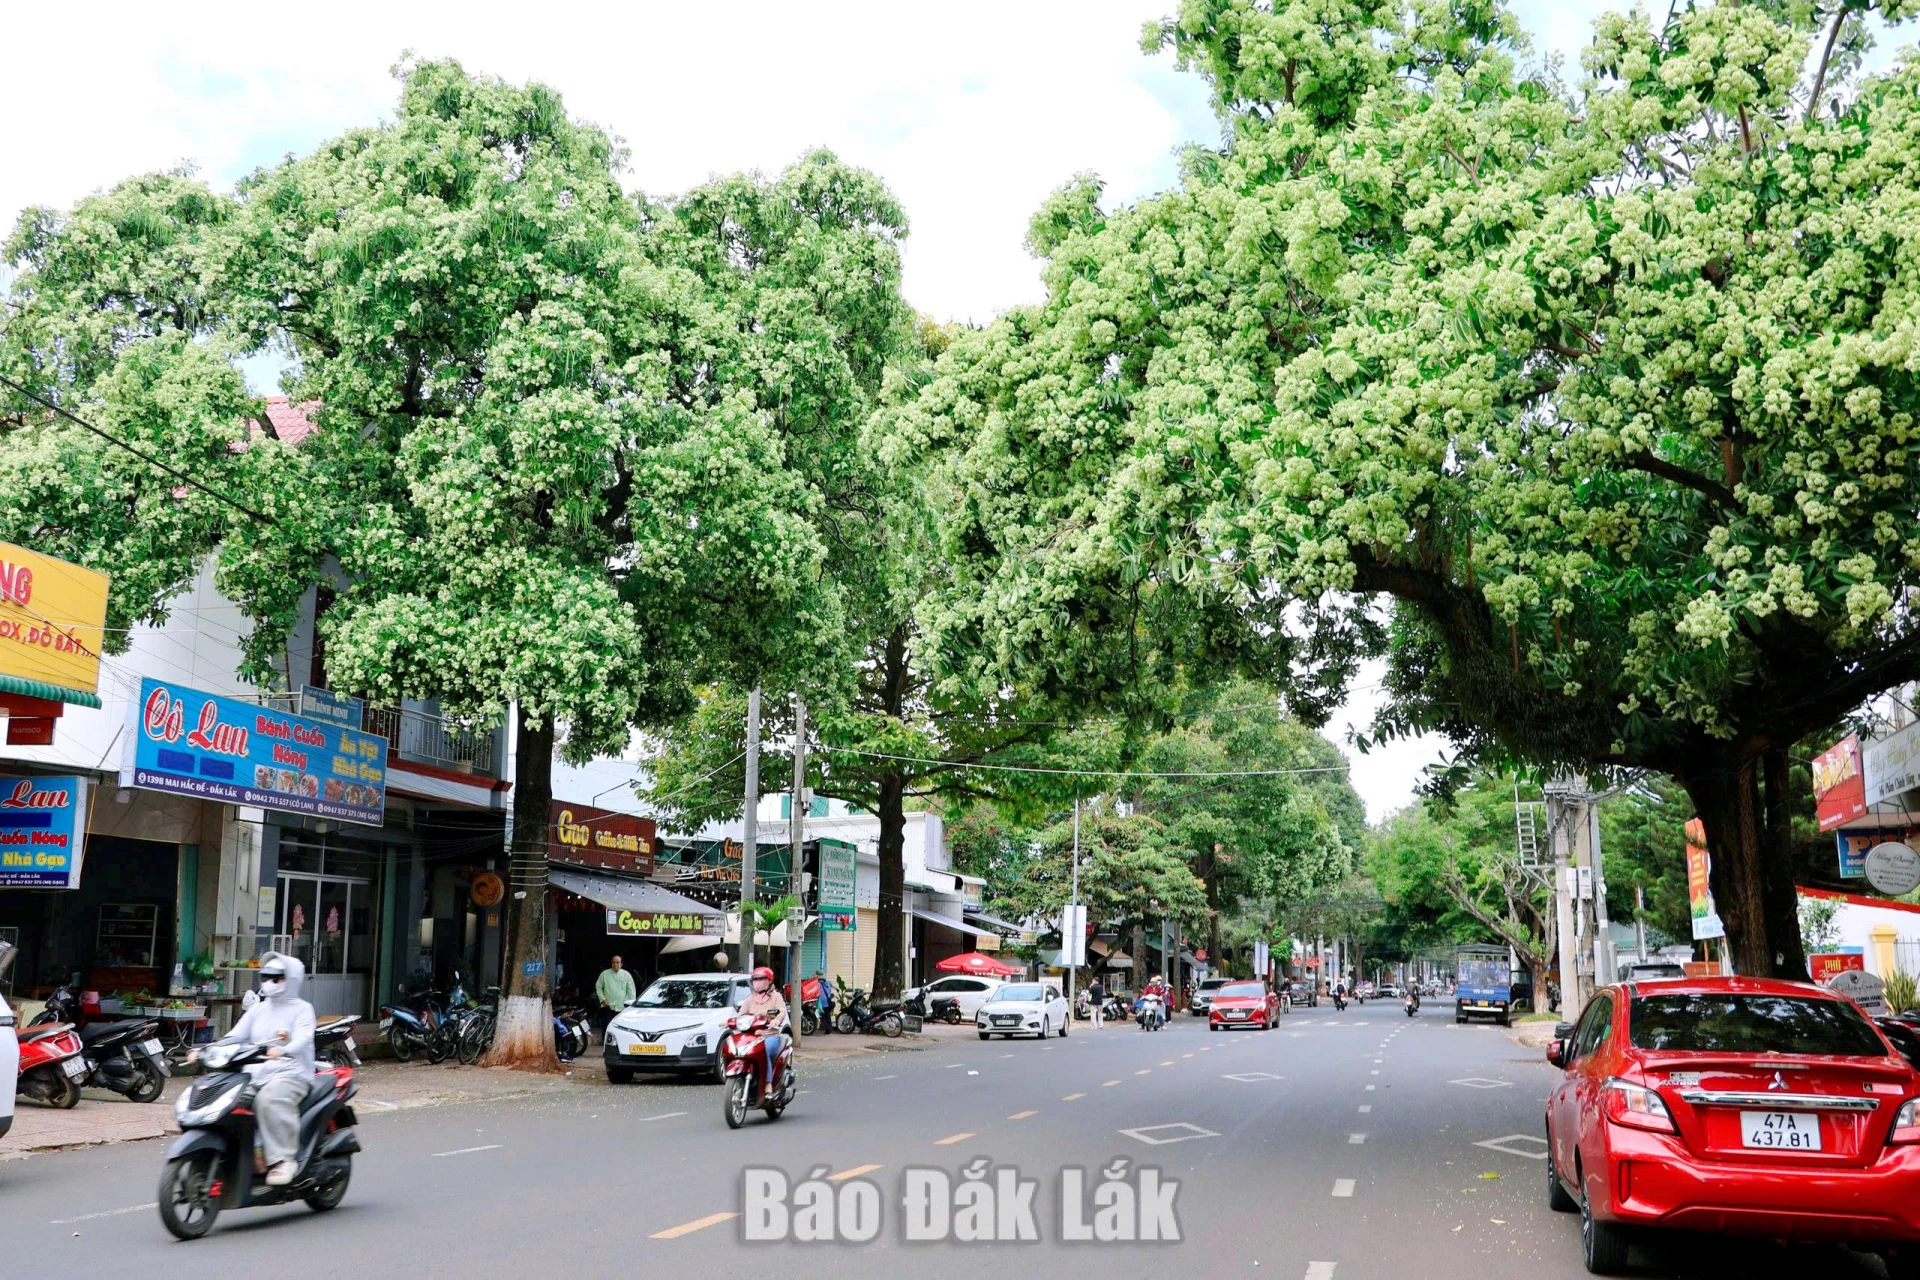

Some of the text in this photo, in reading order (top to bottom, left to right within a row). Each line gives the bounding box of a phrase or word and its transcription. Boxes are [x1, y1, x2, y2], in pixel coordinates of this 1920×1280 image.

[144, 687, 250, 757] Cô Lan
[257, 715, 291, 740] Bánh
[293, 724, 325, 747] Cuốn
[273, 743, 307, 770] Nóng
[147, 775, 164, 785] 139B
[165, 778, 180, 788] MAI
[2, 780, 70, 808] Lan
[251, 794, 268, 804] 0942
[300, 803, 314, 811] LAN)
[323, 805, 338, 814] 0947
[31, 830, 68, 849] Nóng
[557, 810, 589, 853] Gạo
[3, 851, 67, 871] Nhà Gạo
[619, 910, 651, 934] Gạo
[526, 963, 541, 972] 217
[1763, 1113, 1797, 1130] 47A
[1751, 1131, 1811, 1148] 437.81
